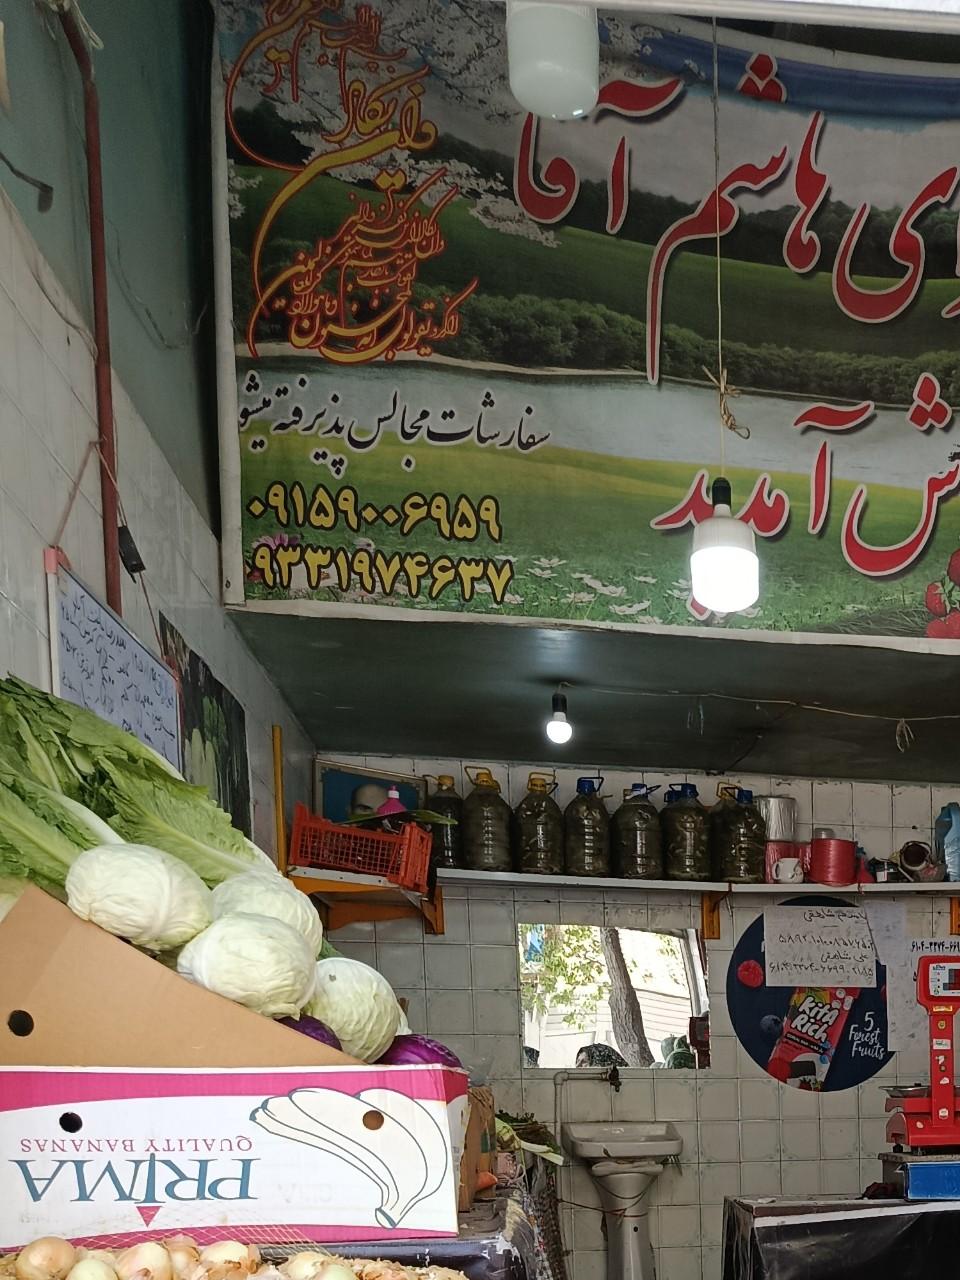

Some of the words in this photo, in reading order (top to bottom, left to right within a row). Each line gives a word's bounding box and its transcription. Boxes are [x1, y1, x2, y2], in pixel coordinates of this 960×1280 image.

[645, 52, 830, 386] هاشم
[271, 374, 348, 478] پذیرفته
[346, 390, 431, 470] مجالس
[424, 390, 552, 452] سفارشات
[246, 480, 502, 542] ۰۹۱۵۹۰۰۶۹۵۹
[791, 1013, 828, 1043] Rich
[848, 1024, 880, 1045] Forest
[863, 1011, 875, 1031] 5
[851, 1040, 886, 1061] Fruits
[20, 1136, 135, 1154] BANANAS
[145, 1134, 254, 1153] QUALITY
[9, 1151, 262, 1203] PRIMA
